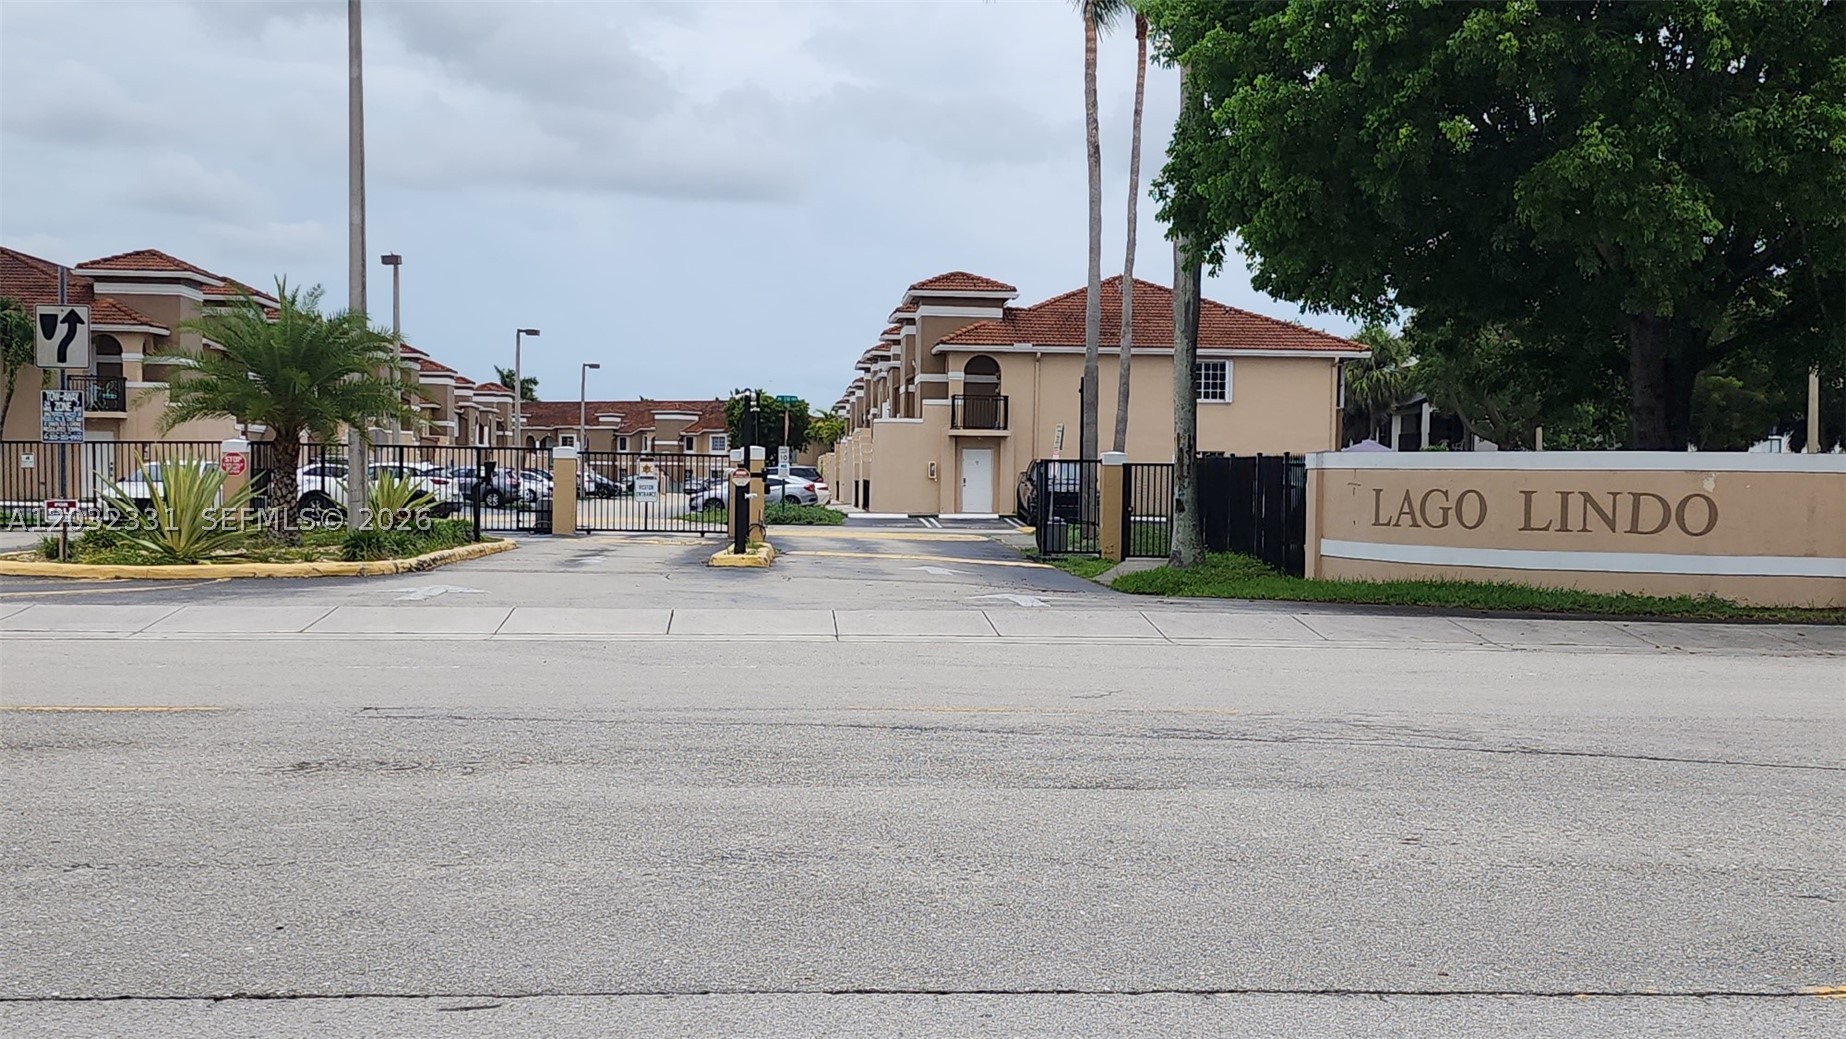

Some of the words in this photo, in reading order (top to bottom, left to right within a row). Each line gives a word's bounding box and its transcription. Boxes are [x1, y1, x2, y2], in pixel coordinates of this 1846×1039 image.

[46, 391, 79, 402] TOW-AWAY
[54, 401, 73, 412] ZONE
[224, 455, 242, 463] STOP
[1371, 488, 1488, 530] LAGO
[1518, 490, 1719, 537] LINDO
